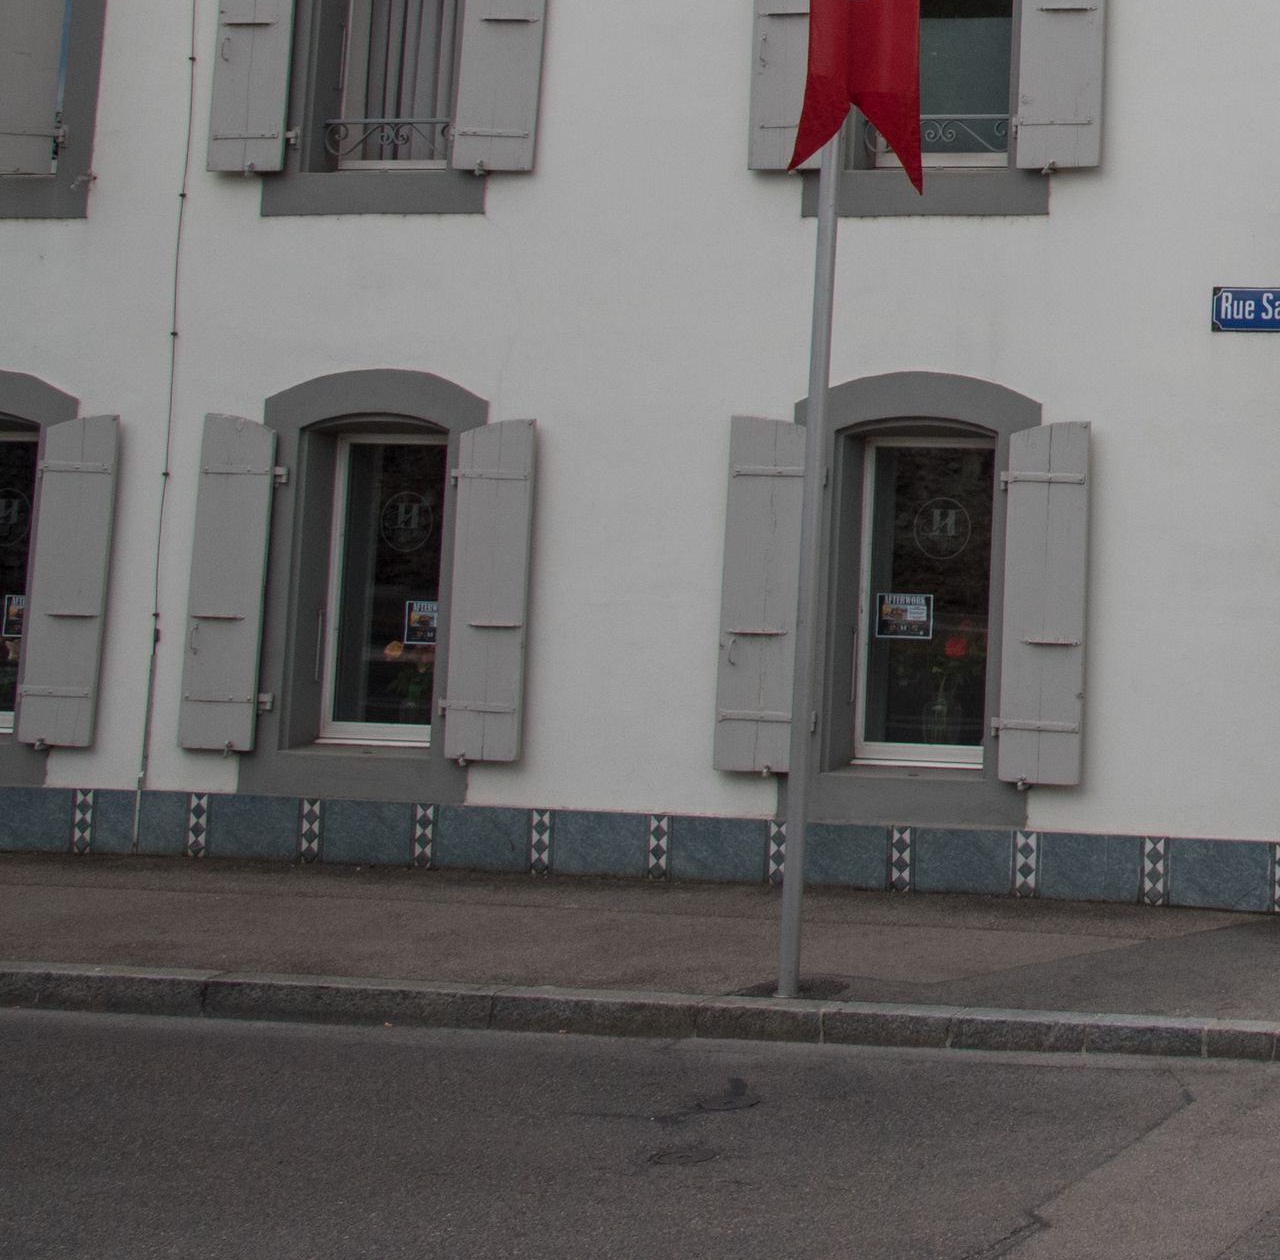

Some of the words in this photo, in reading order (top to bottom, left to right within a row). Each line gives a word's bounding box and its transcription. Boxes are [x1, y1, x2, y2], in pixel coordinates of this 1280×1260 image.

[1221, 292, 1255, 320] Rue
[885, 595, 926, 605] AFTERWORK
[413, 602, 438, 612] AFTERW
